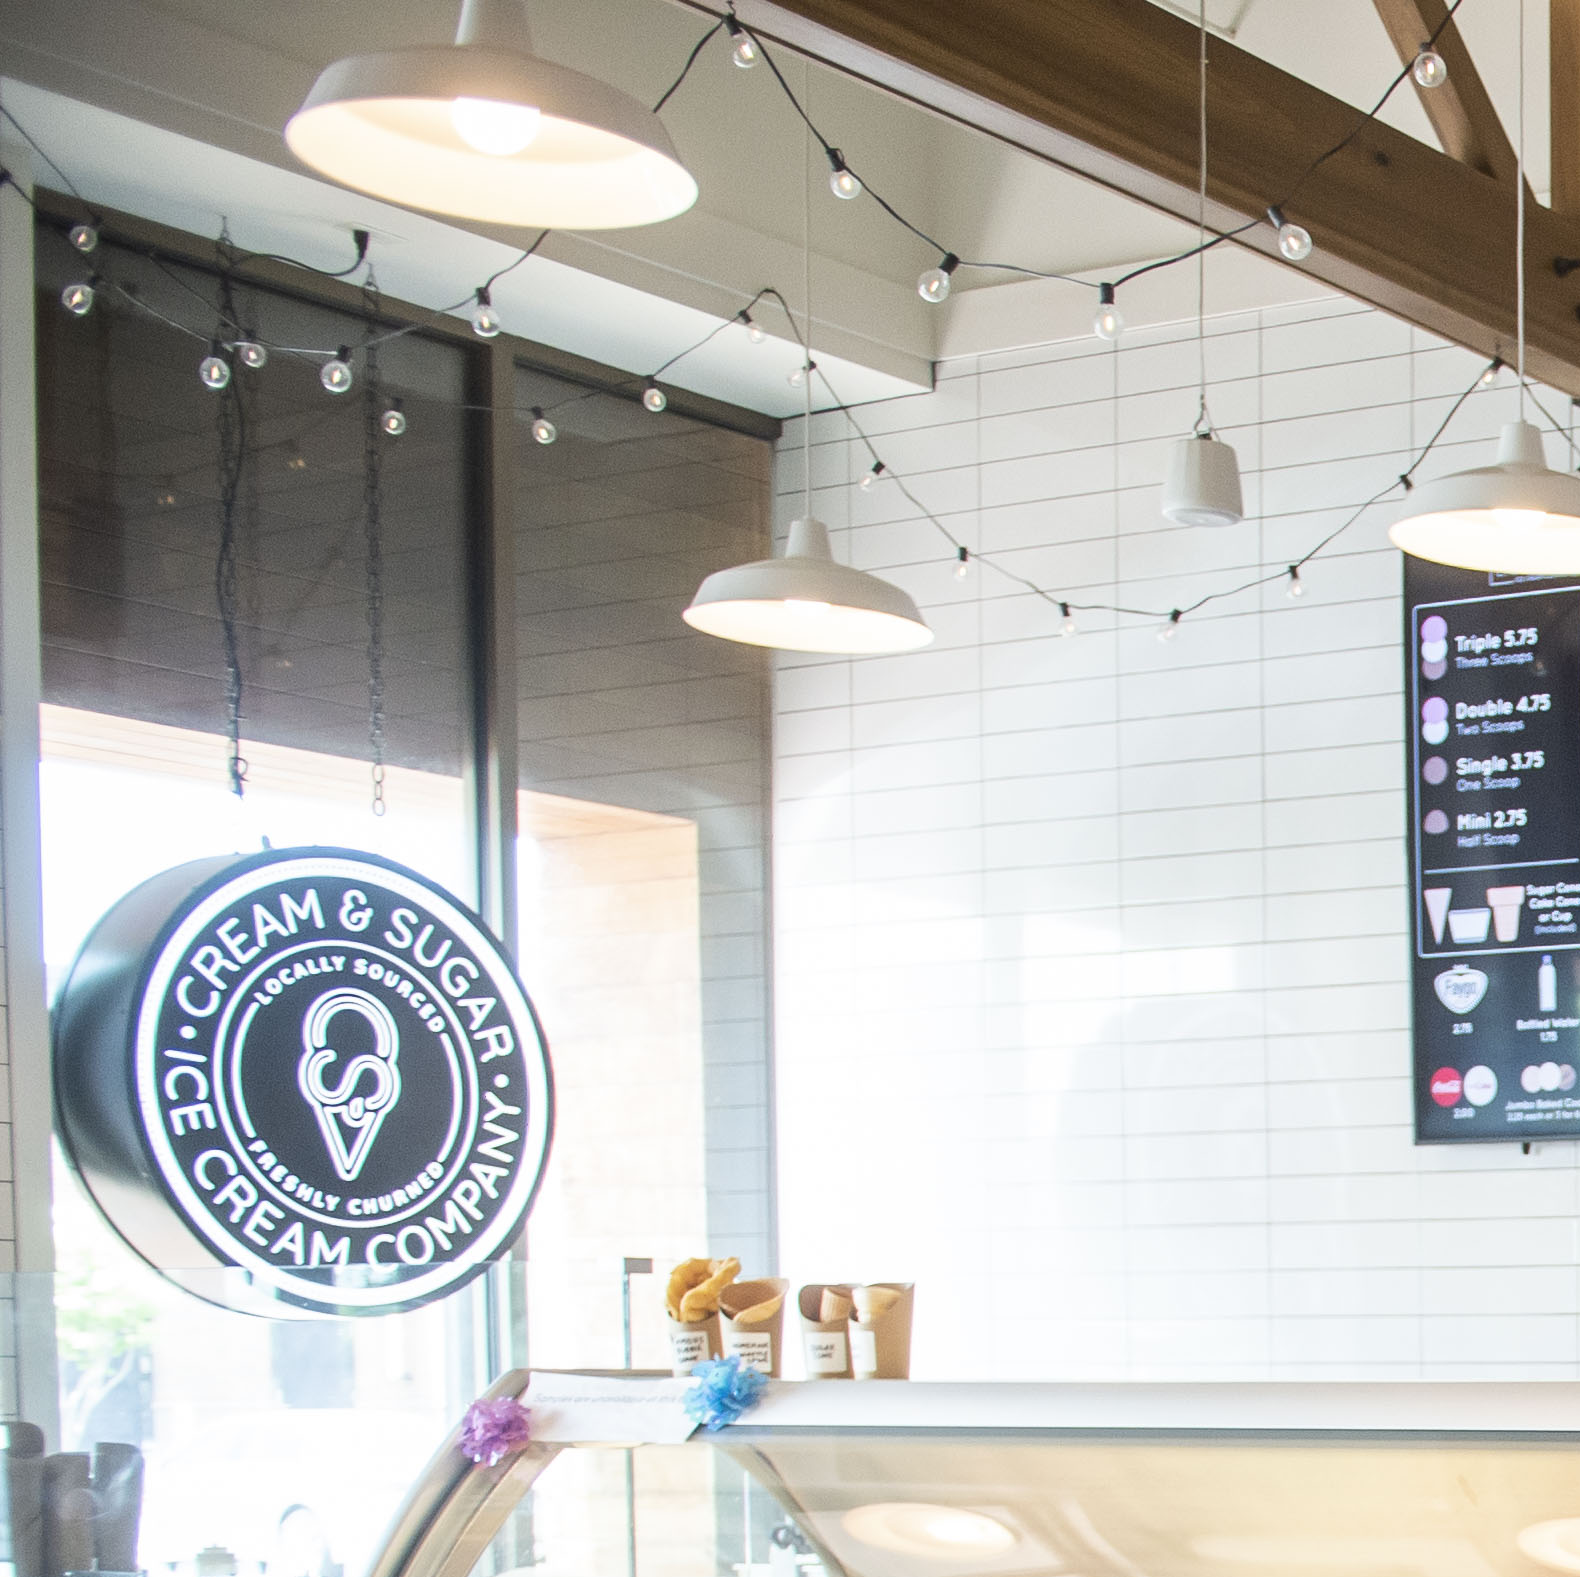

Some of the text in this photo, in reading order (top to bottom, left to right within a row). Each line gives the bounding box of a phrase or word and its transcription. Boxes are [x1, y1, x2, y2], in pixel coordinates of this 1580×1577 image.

[1455, 628, 1539, 654] Triple 5.75
[1455, 693, 1551, 719] Double 4.75
[1456, 751, 1545, 776] Single 3.75
[1457, 809, 1527, 831] Mini 2.75
[176, 888, 516, 1064] CREAM & SUGAR
[254, 956, 446, 1034] LOCALLY SOURCED
[164, 1049, 521, 1275] ICE CREAM COMPANY
[247, 1136, 446, 1217] FRESHLY CHURNED
